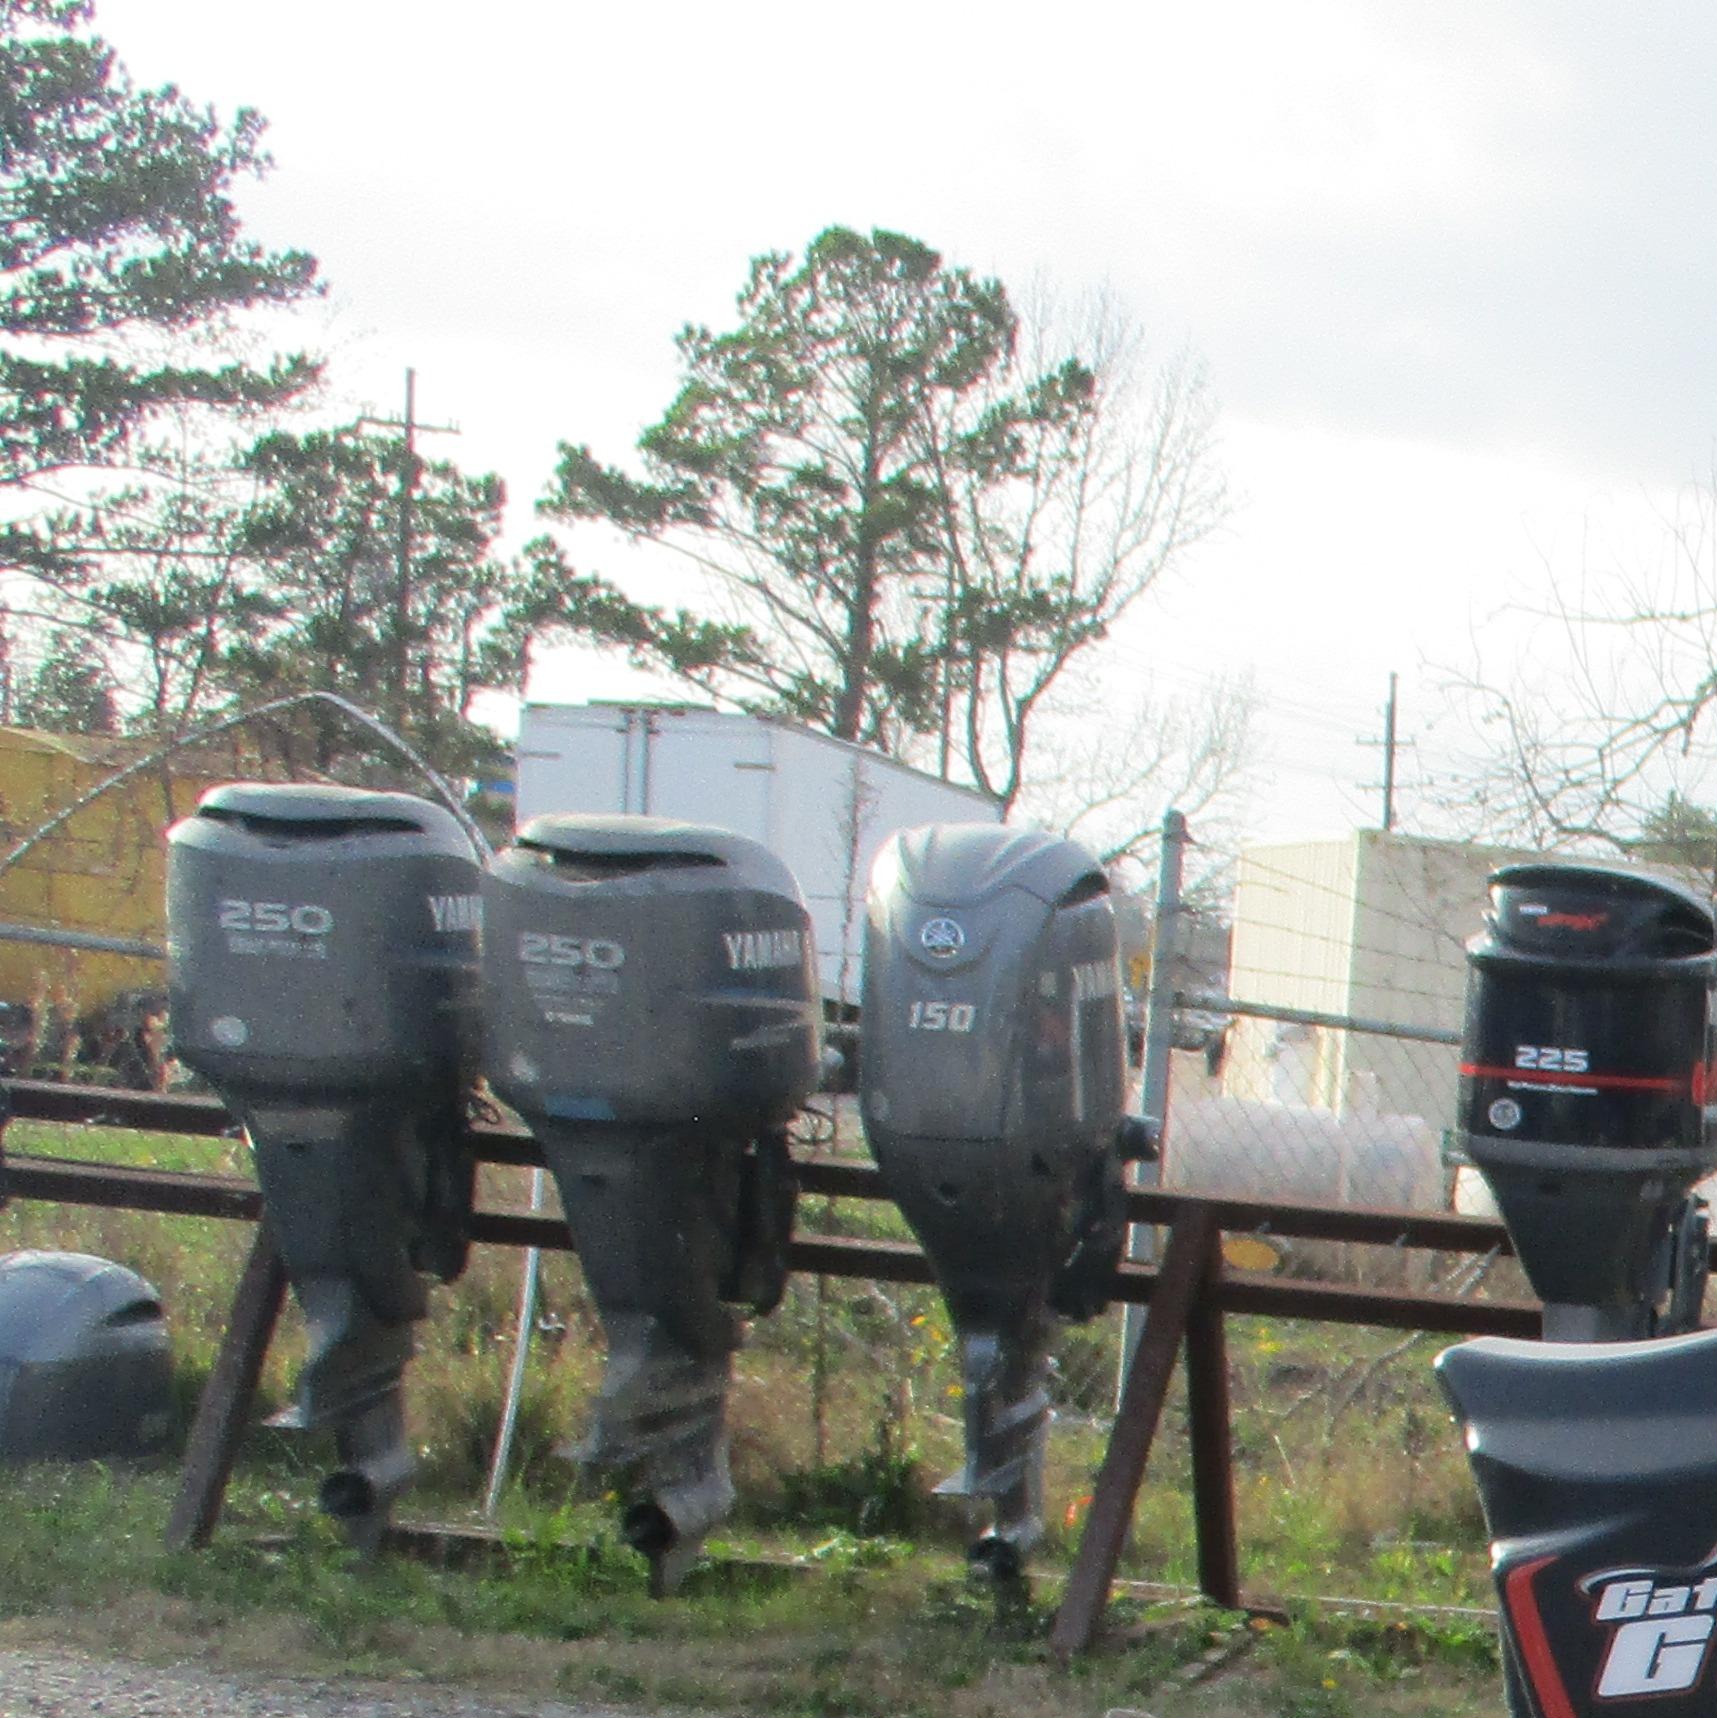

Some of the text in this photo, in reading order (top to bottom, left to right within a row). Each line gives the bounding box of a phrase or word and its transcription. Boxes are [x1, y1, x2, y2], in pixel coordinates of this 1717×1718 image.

[218, 899, 334, 934] 250
[519, 931, 625, 969] 250
[909, 1001, 976, 1033] 150
[1515, 1045, 1589, 1073] 225
